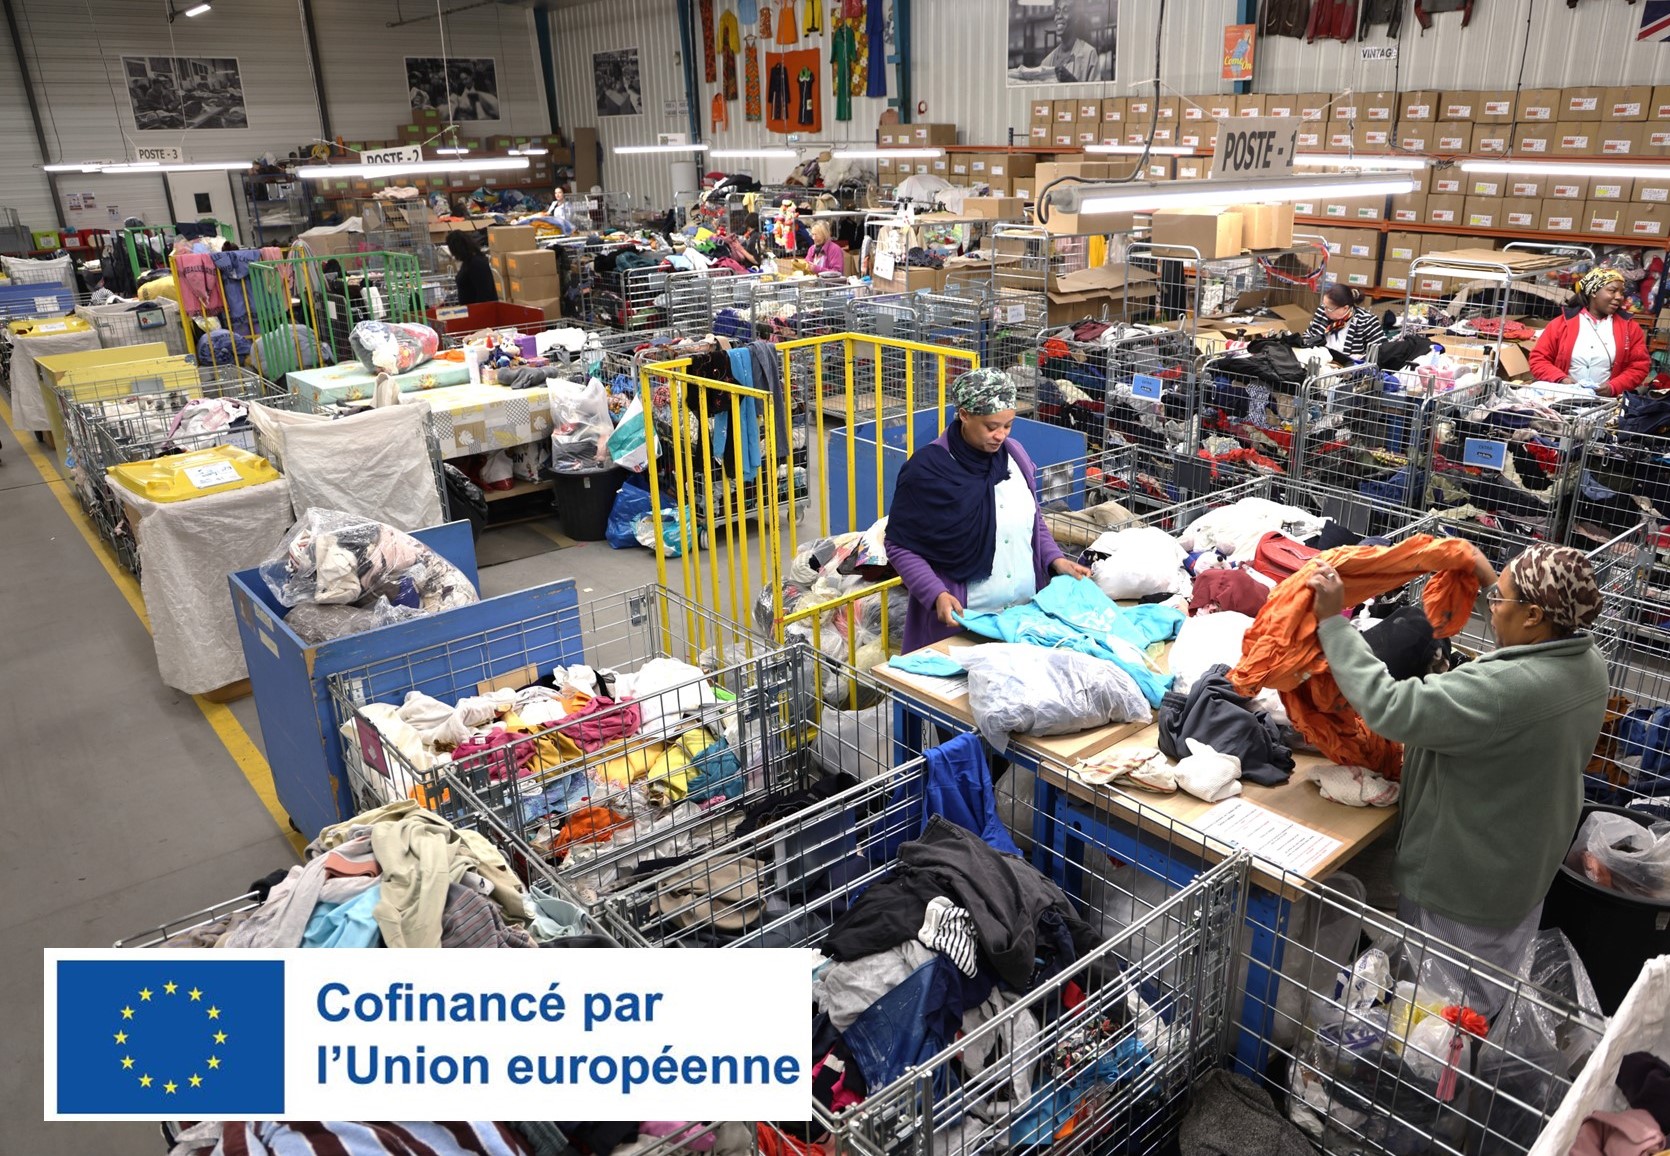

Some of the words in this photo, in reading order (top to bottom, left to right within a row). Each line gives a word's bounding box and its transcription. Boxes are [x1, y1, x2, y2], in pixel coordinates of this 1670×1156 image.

[138, 149, 165, 160] POSTE
[172, 149, 178, 160] 3
[366, 151, 404, 164] POSTE
[1222, 130, 1276, 172] POSTE
[1286, 130, 1297, 168] 1
